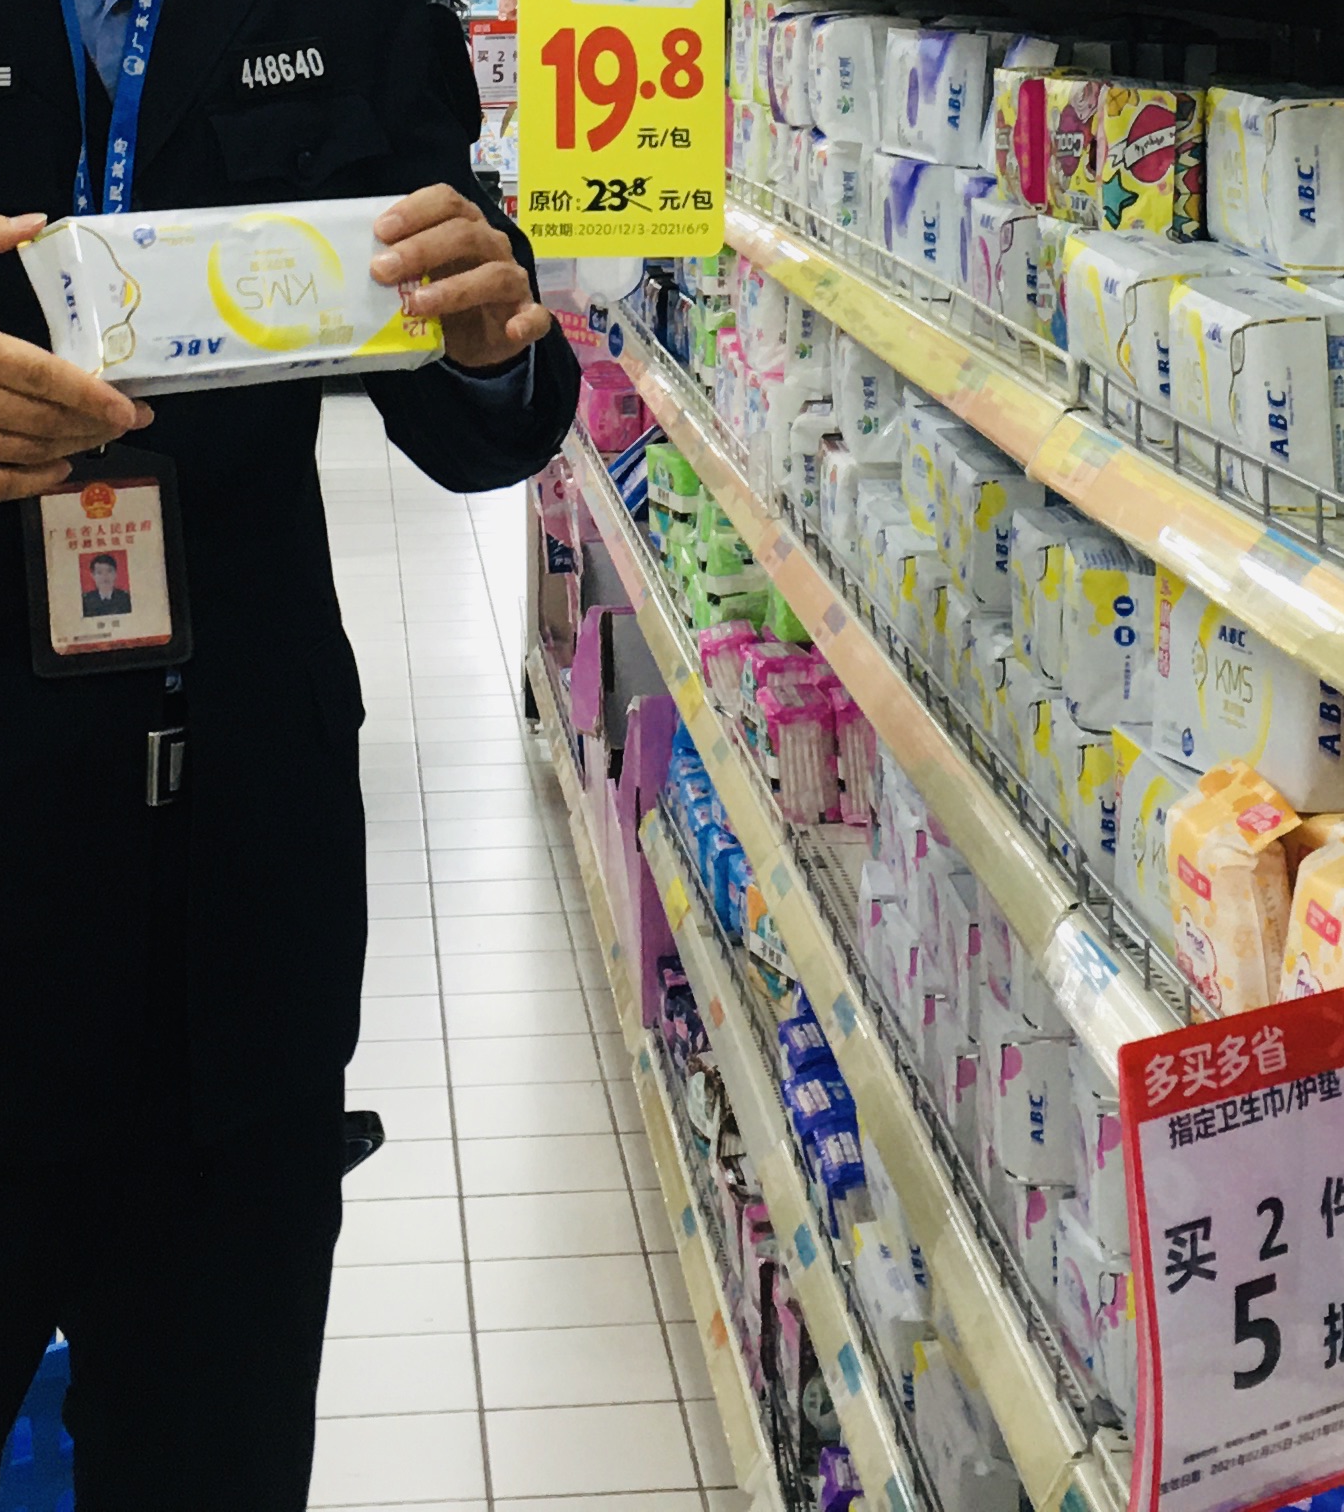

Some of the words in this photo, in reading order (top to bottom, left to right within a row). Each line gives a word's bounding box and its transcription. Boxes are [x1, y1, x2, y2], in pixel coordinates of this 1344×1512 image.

[240, 46, 325, 90] 448640
[477, 50, 490, 63] 买
[497, 50, 506, 62] 2
[491, 63, 505, 84] 5
[541, 25, 704, 153] 19.8
[946, 82, 963, 131] ABC
[636, 126, 692, 150] 元/包
[528, 189, 582, 213] 原价:
[658, 188, 714, 212] 元/包
[1297, 163, 1317, 228] ABC
[924, 214, 938, 264] ABC
[168, 336, 227, 360] ABC
[1267, 388, 1291, 464] ABC
[995, 528, 1010, 574] ABC
[1217, 624, 1247, 648] ABC
[1144, 1024, 1289, 1109] 多买多省
[1028, 1093, 1046, 1146] ABC
[1167, 1069, 1344, 1150] 指定卫生巾/护垫
[1163, 1215, 1218, 1296] 买
[1256, 1196, 1289, 1262] 2
[1232, 1272, 1283, 1391] 5
